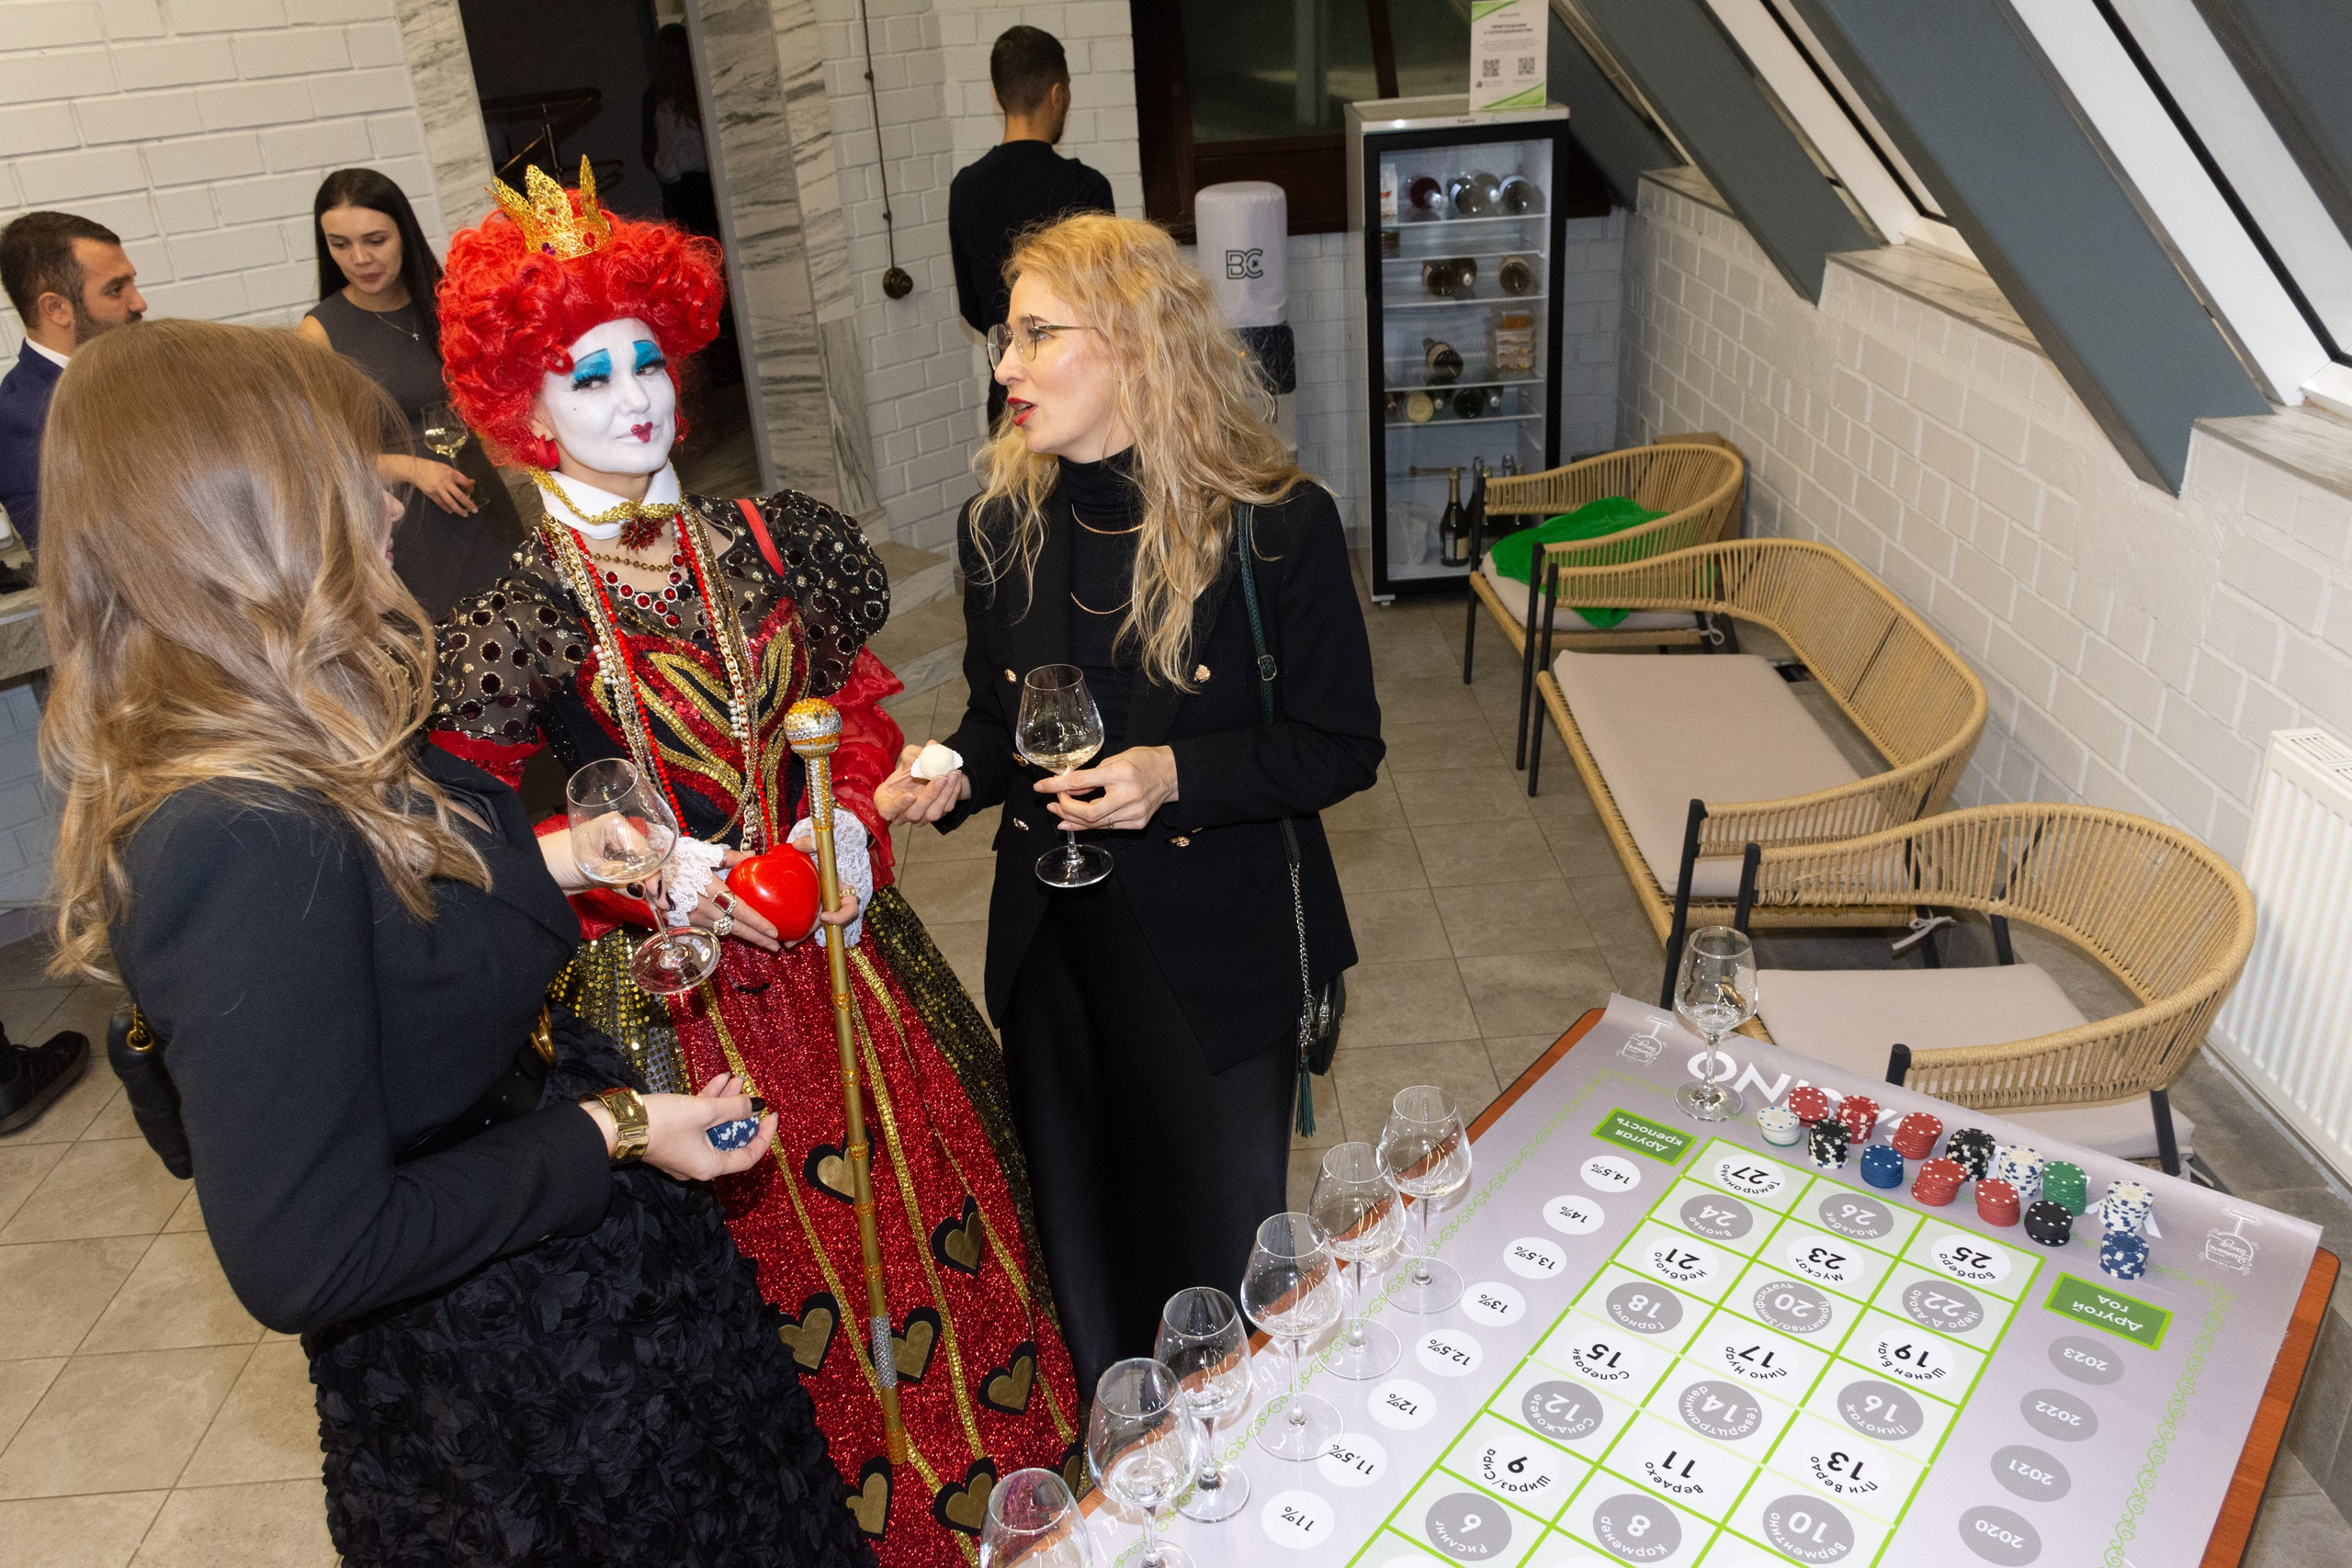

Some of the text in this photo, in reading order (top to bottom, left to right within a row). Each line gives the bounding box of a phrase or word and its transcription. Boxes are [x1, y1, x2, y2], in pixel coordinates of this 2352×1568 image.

[1615, 1130, 1668, 1152] Другая
[1617, 1118, 1682, 1145] крепость
[1591, 1164, 1630, 1184] 14,5%
[1720, 1165, 1780, 1194] Темпранильо
[1732, 1167, 1770, 1184] 27
[1560, 1206, 1588, 1223] 14%
[1689, 1216, 1732, 1236] Вионье
[1700, 1205, 1737, 1226] 24
[1826, 1212, 1878, 1236] Мальбек
[1841, 1204, 1877, 1225] 26
[1515, 1247, 1555, 1269] 13,5%
[1655, 1252, 1706, 1280] Неббиоло
[1665, 1248, 1700, 1269] 21
[1796, 1258, 1843, 1281] Мускат
[1808, 1248, 1847, 1269] 23
[1939, 1253, 1996, 1279] Барбера
[1951, 1247, 1993, 1269] 25
[1478, 1294, 1509, 1313] 13%
[1628, 1294, 1661, 1318] 18
[1754, 1283, 1829, 1331] Примитиво/Зинфандель
[1775, 1293, 1815, 1317] 20
[1924, 1292, 1965, 1316] 22
[2098, 1295, 2129, 1313] год
[1612, 1304, 1665, 1329] Гарнача
[1949, 1312, 1978, 1327] Неро
[2073, 1302, 2143, 1331] Другой
[1428, 1339, 1470, 1365] 12,5%
[1573, 1348, 1629, 1380] Саперави
[1586, 1344, 1622, 1369] 15
[1726, 1347, 1787, 1379] Пино Нуар
[1738, 1346, 1774, 1368] 17
[1878, 1342, 1946, 1380] Шенен Блан
[1894, 1344, 1928, 1367] 19
[2063, 1348, 2108, 1371] 2023
[1386, 1393, 1418, 1415] 12%
[1531, 1393, 1594, 1434] Санджовезе
[1545, 1393, 1580, 1422] 12
[1686, 1386, 1758, 1436] Гевюрцтраминер
[1702, 1394, 1738, 1422] 14
[1864, 1395, 1897, 1422] 16
[2035, 1400, 2082, 1427] 2022
[1846, 1403, 1907, 1435] Пинотаж
[1329, 1444, 1374, 1474] 11,5%
[1483, 1449, 1551, 1492] Шираз/Сира
[1508, 1457, 1528, 1473] 9
[1662, 1450, 1695, 1478] 11
[1827, 1451, 1863, 1481] 13
[1645, 1462, 1703, 1493] Вердехо
[1811, 1456, 1878, 1493] Пти Вердо
[2008, 1459, 2054, 1485] 2021
[1281, 1506, 1315, 1531] 11%
[1460, 1514, 1481, 1533] 6
[1627, 1515, 1650, 1537] 8
[1789, 1512, 1827, 1543] 10
[1435, 1520, 1487, 1553] Рислинг
[1601, 1517, 1667, 1557] Карменер
[1770, 1513, 1847, 1559] Верментино
[1975, 1519, 2025, 1549] 2020
